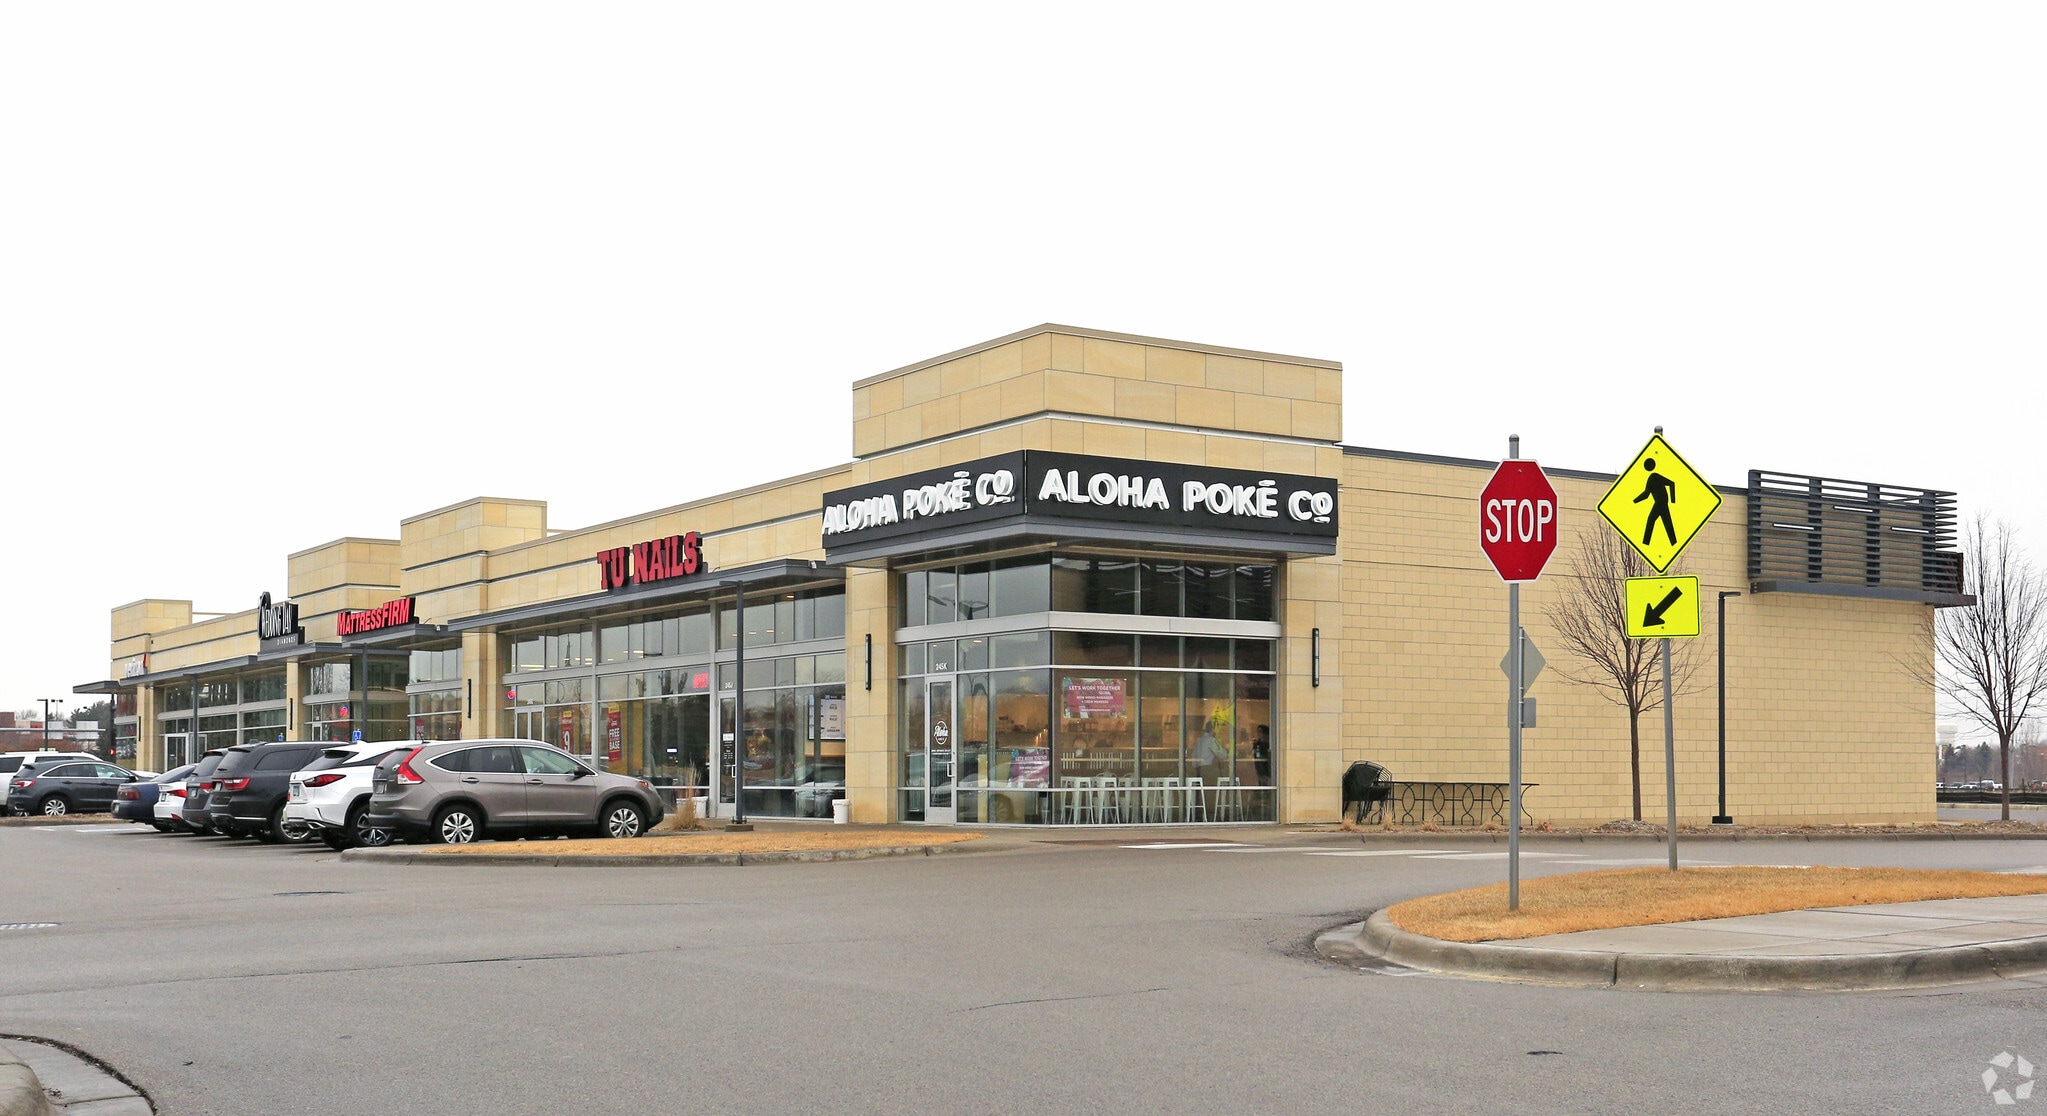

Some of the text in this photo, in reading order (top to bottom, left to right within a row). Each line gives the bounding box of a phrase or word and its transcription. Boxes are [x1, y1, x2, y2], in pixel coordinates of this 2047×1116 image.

[1039, 468, 1170, 510] ALOHA
[822, 494, 899, 535] ALOHA
[1485, 498, 1553, 543] STOP
[597, 531, 703, 590] TU NAILS
[608, 728, 620, 738] FREE
[609, 740, 620, 750] BASE
